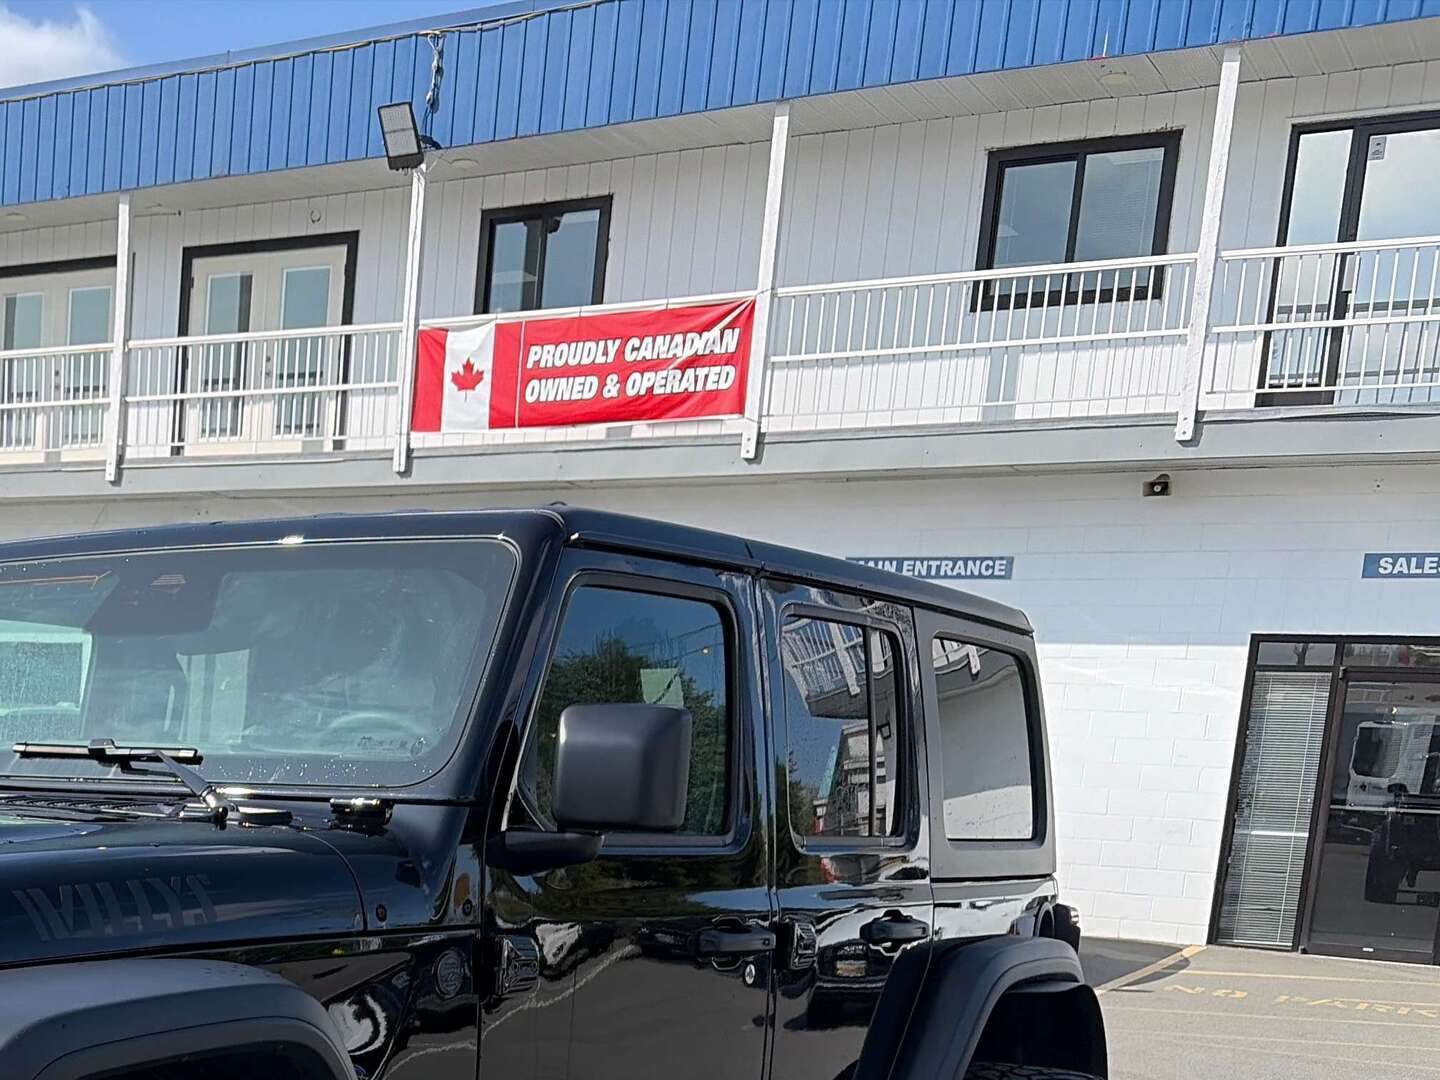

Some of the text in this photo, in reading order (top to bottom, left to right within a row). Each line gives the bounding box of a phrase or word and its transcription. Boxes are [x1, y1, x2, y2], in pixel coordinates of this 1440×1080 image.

[526, 328, 741, 369] PROUDLY CANADIAN
[524, 365, 737, 404] OWNED & OPERATED
[902, 559, 1007, 577] ENTRANCE
[1378, 556, 1440, 575] SALE
[12, 873, 213, 941] WILLYS
